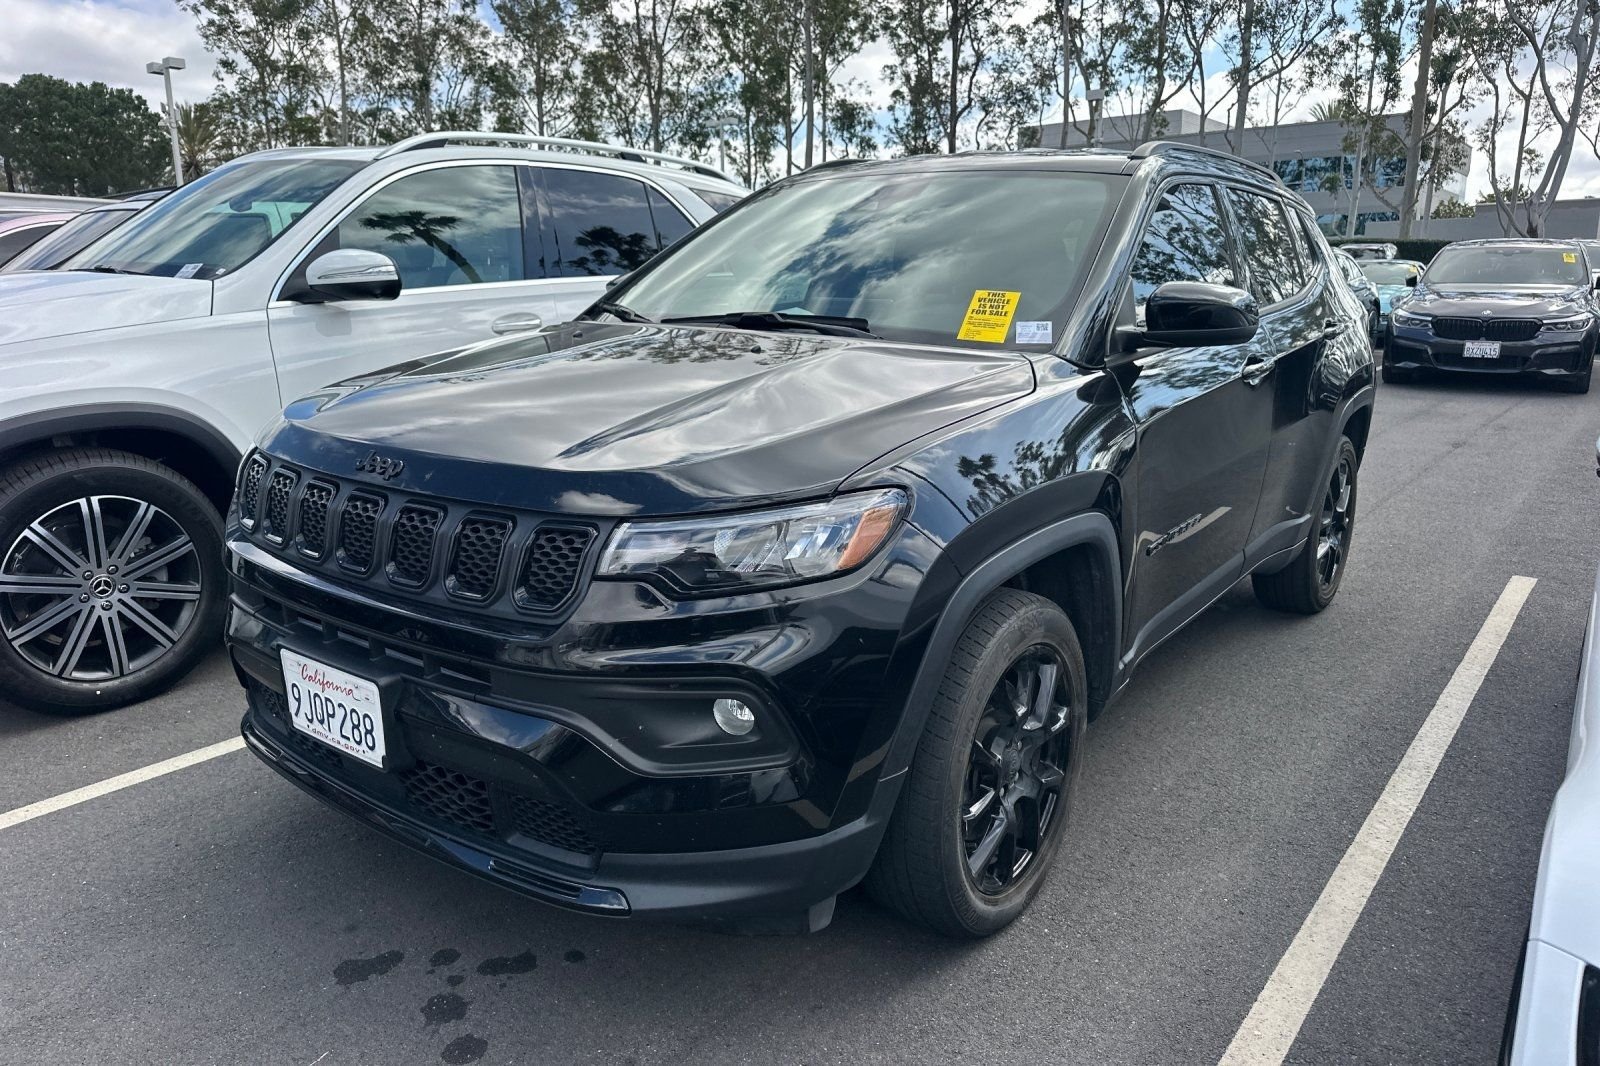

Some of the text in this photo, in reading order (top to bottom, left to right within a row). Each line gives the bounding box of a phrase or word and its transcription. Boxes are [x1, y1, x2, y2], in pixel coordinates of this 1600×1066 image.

[356, 450, 404, 481] Jeep
[301, 663, 359, 701] California
[291, 682, 376, 751] 9JQP288
[312, 728, 360, 752] dmv.ca.gov
